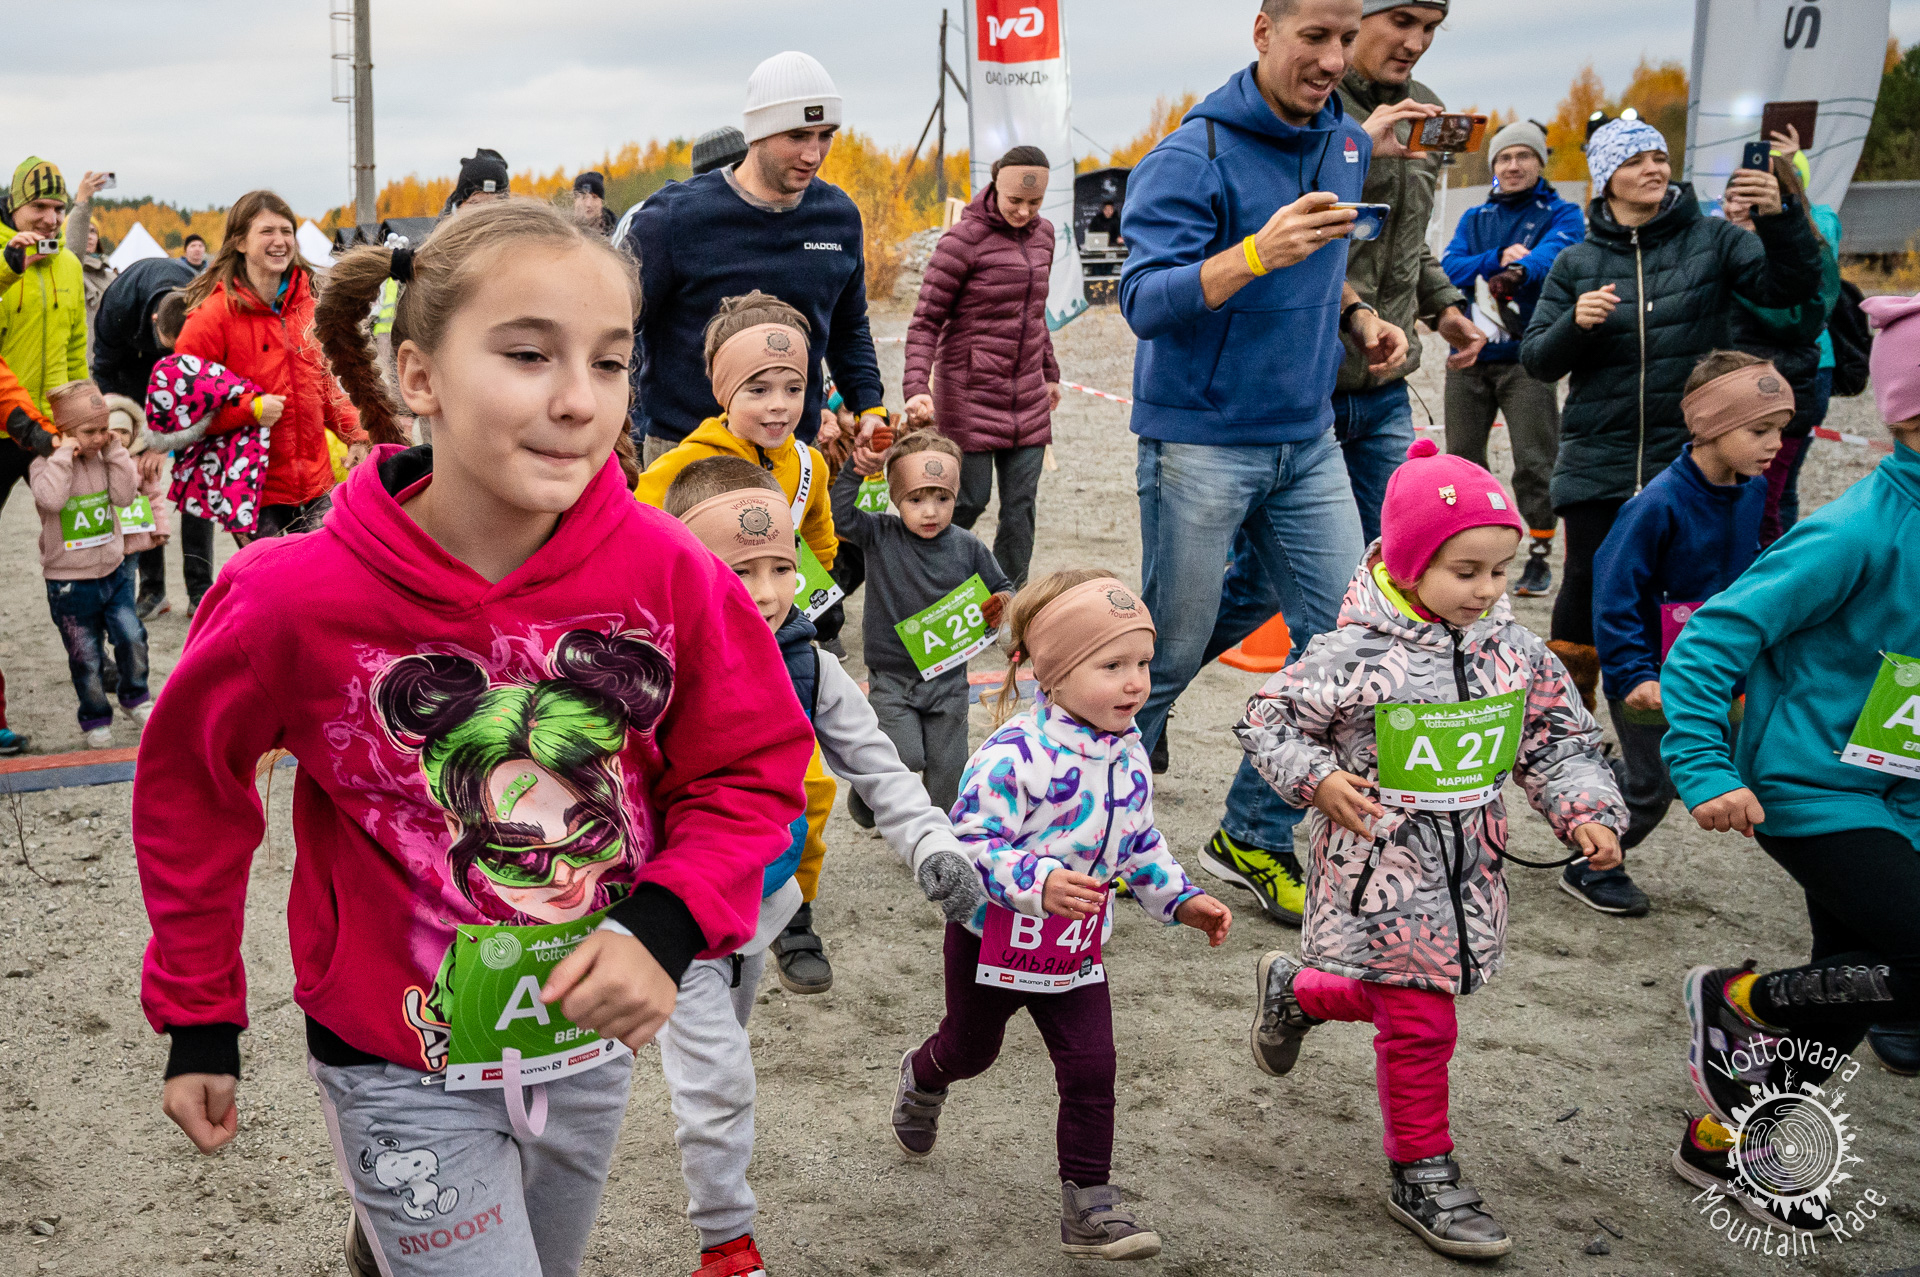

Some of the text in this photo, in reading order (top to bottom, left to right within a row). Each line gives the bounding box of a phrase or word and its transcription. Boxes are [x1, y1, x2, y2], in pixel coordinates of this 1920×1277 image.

[1784, 0, 1821, 49] S
[804, 242, 842, 251] DIADORA
[797, 467, 811, 503] TITAN
[730, 498, 769, 511] Vottovaara
[858, 493, 871, 508] A
[74, 511, 91, 531] A
[733, 529, 781, 546] Mountain Race
[923, 603, 984, 655] A 28
[950, 636, 973, 652] ИГОРЬ
[1424, 719, 1466, 729] Vottovaara
[1468, 712, 1497, 726] Mountain
[1883, 694, 1920, 736] A
[1404, 725, 1505, 772] A 27
[1436, 773, 1484, 787] МАРИНА
[1010, 912, 1099, 954] B 42
[998, 949, 1076, 975] УЛЬЯНА
[495, 975, 550, 1031] A
[569, 1049, 600, 1064] NUTREND
[398, 1203, 504, 1256] SNOOPY
